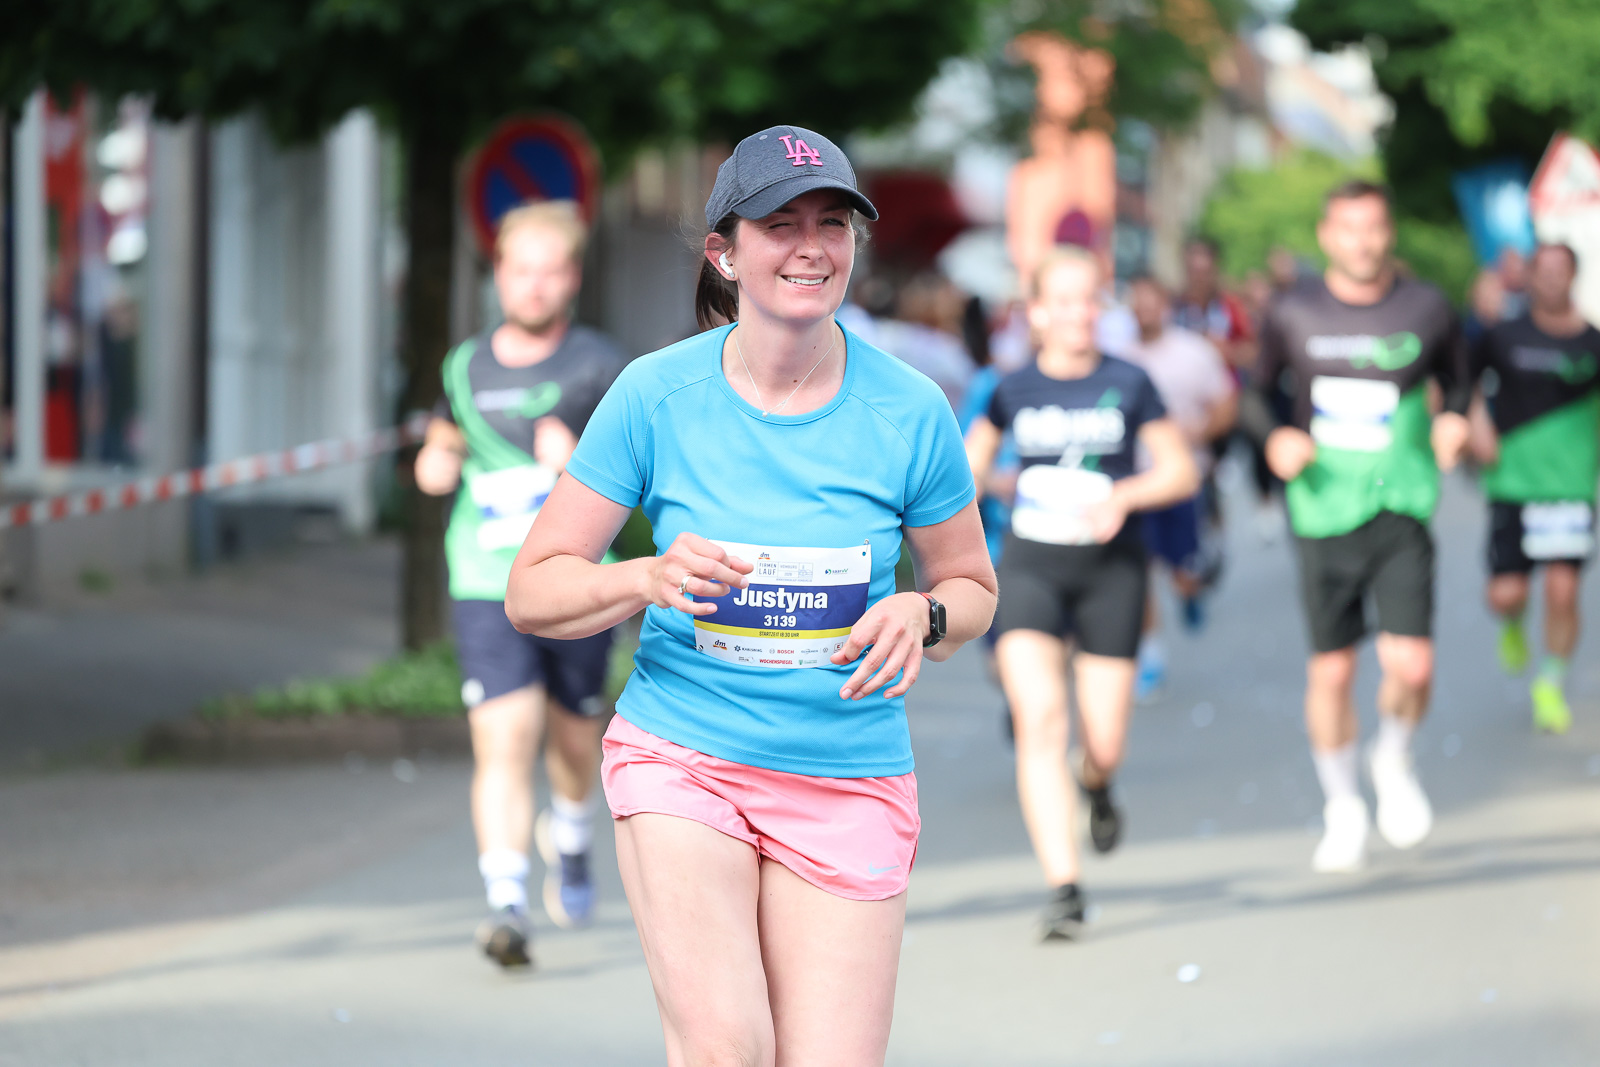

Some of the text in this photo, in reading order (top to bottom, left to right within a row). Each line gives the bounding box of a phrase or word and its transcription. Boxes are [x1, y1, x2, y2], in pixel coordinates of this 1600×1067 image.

[778, 135, 823, 166] LA
[758, 568, 776, 576] LAUF
[733, 587, 828, 613] Justyna
[763, 615, 797, 627] 3139
[714, 639, 726, 647] dm
